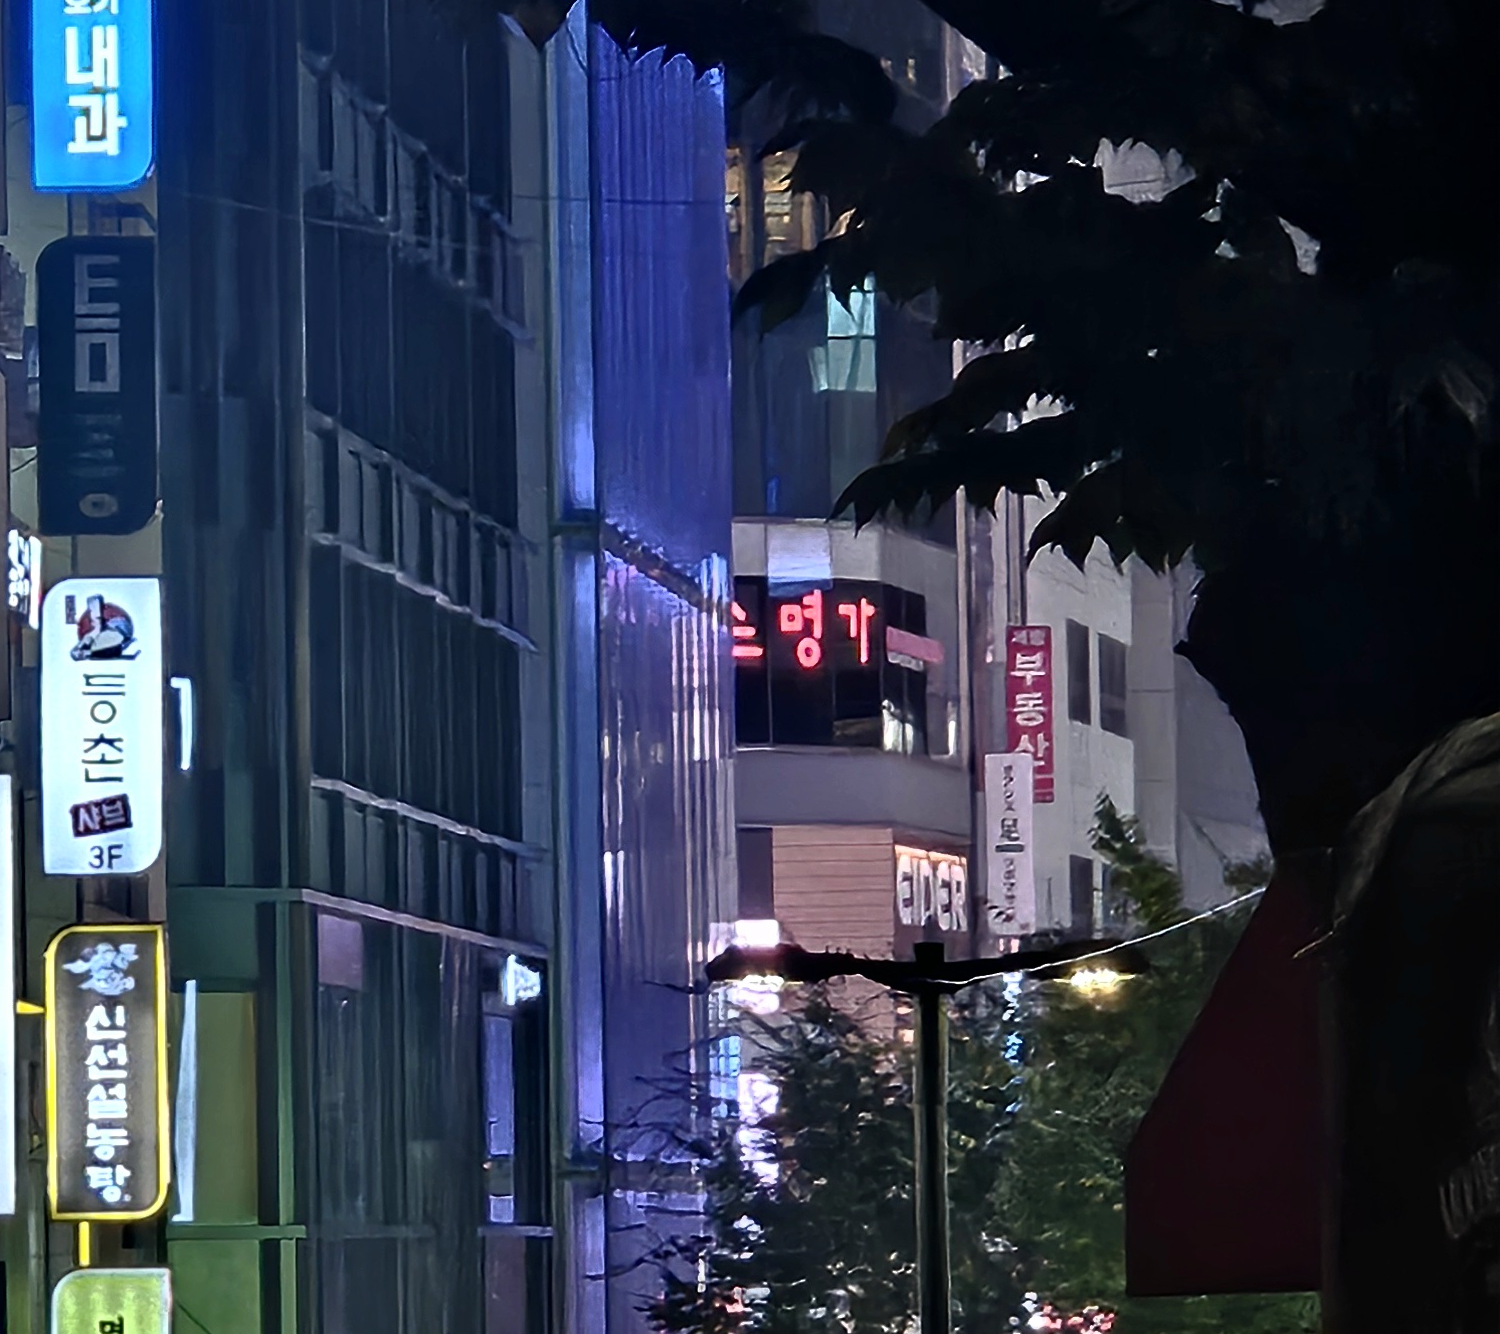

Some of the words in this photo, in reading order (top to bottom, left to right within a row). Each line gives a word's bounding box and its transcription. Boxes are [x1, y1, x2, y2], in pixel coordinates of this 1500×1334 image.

[65, 25, 127, 155] 내과
[82, 673, 125, 783] 등촌
[1010, 652, 1049, 766] 부동산
[78, 800, 126, 832] 샤브
[88, 844, 123, 869] 3F
[85, 1002, 131, 1202] 신선설농탕
